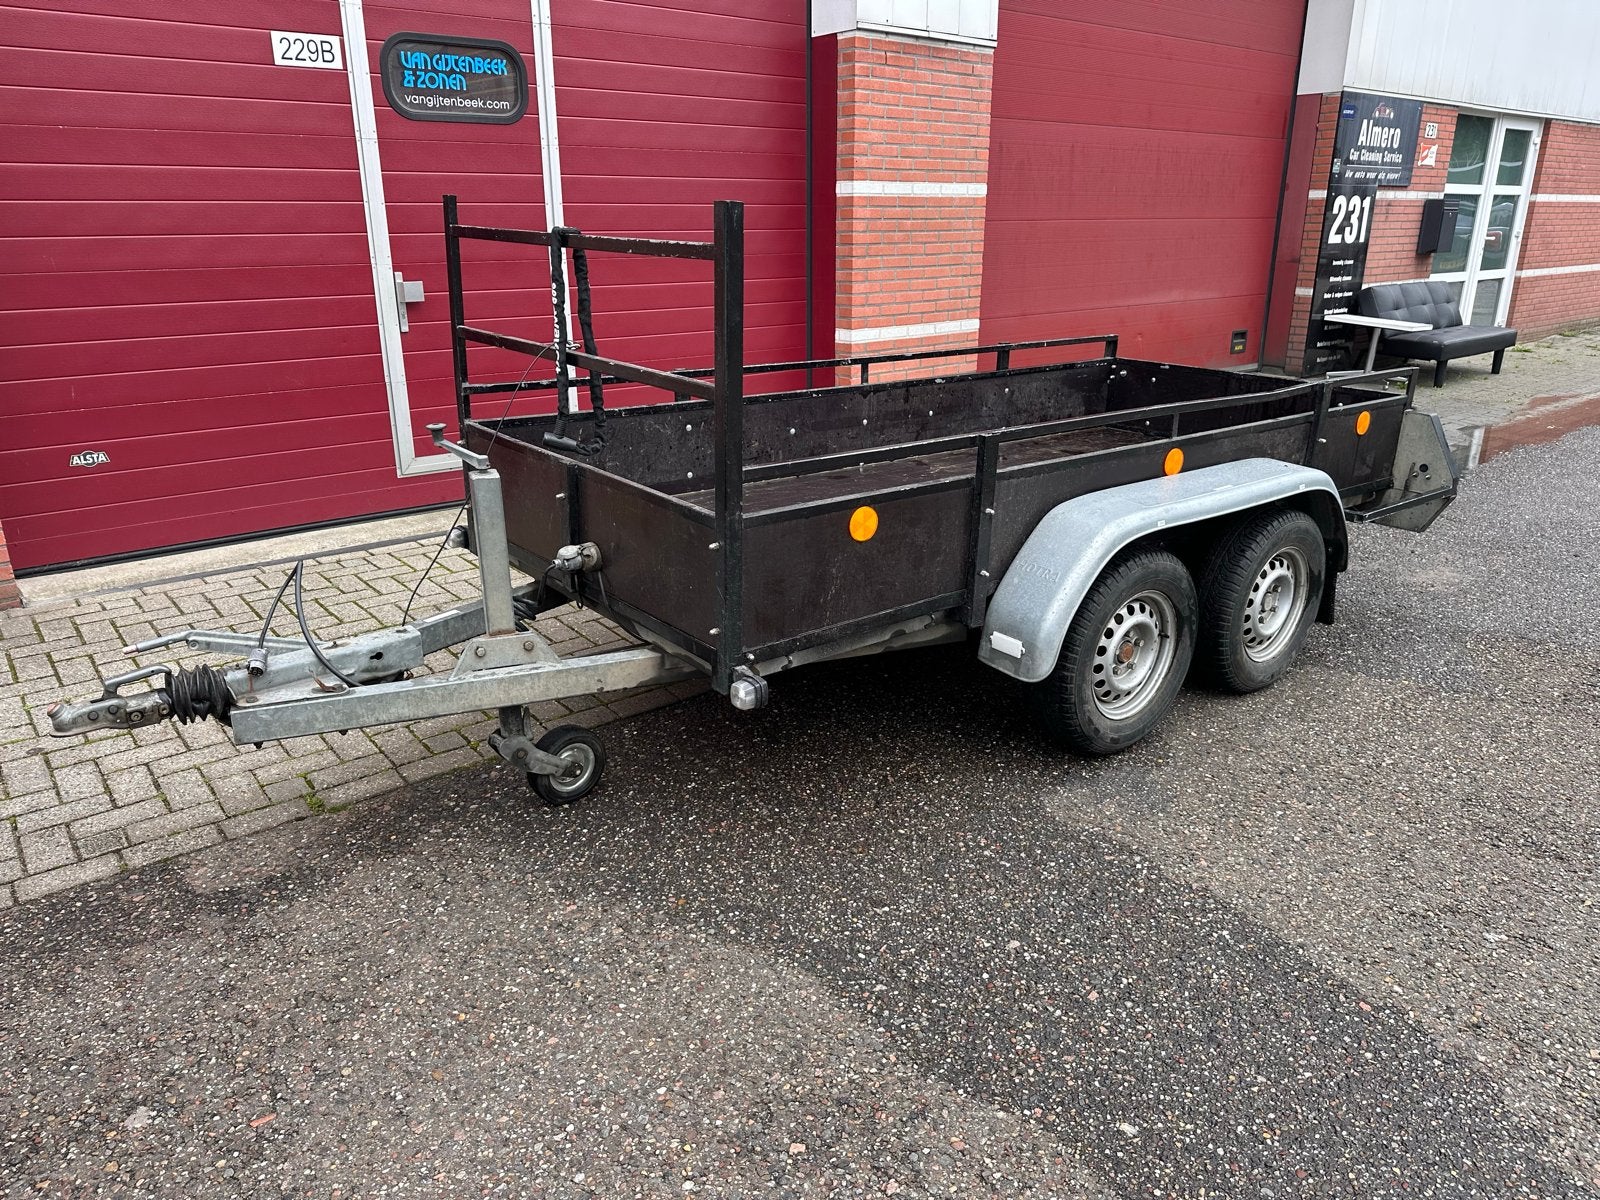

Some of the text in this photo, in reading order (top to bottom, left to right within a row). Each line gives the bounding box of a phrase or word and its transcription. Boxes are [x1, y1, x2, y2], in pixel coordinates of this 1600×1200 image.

[279, 37, 336, 63] 229B
[400, 50, 508, 76] VAN GIJTENBEEK
[403, 70, 467, 91] & ZONEN
[404, 93, 510, 110] vangijtenbeek.com
[1357, 118, 1402, 149] Almero
[1349, 148, 1403, 164] Car Cleaning Service
[1328, 195, 1372, 245] 231
[72, 453, 107, 465] ALSTA
